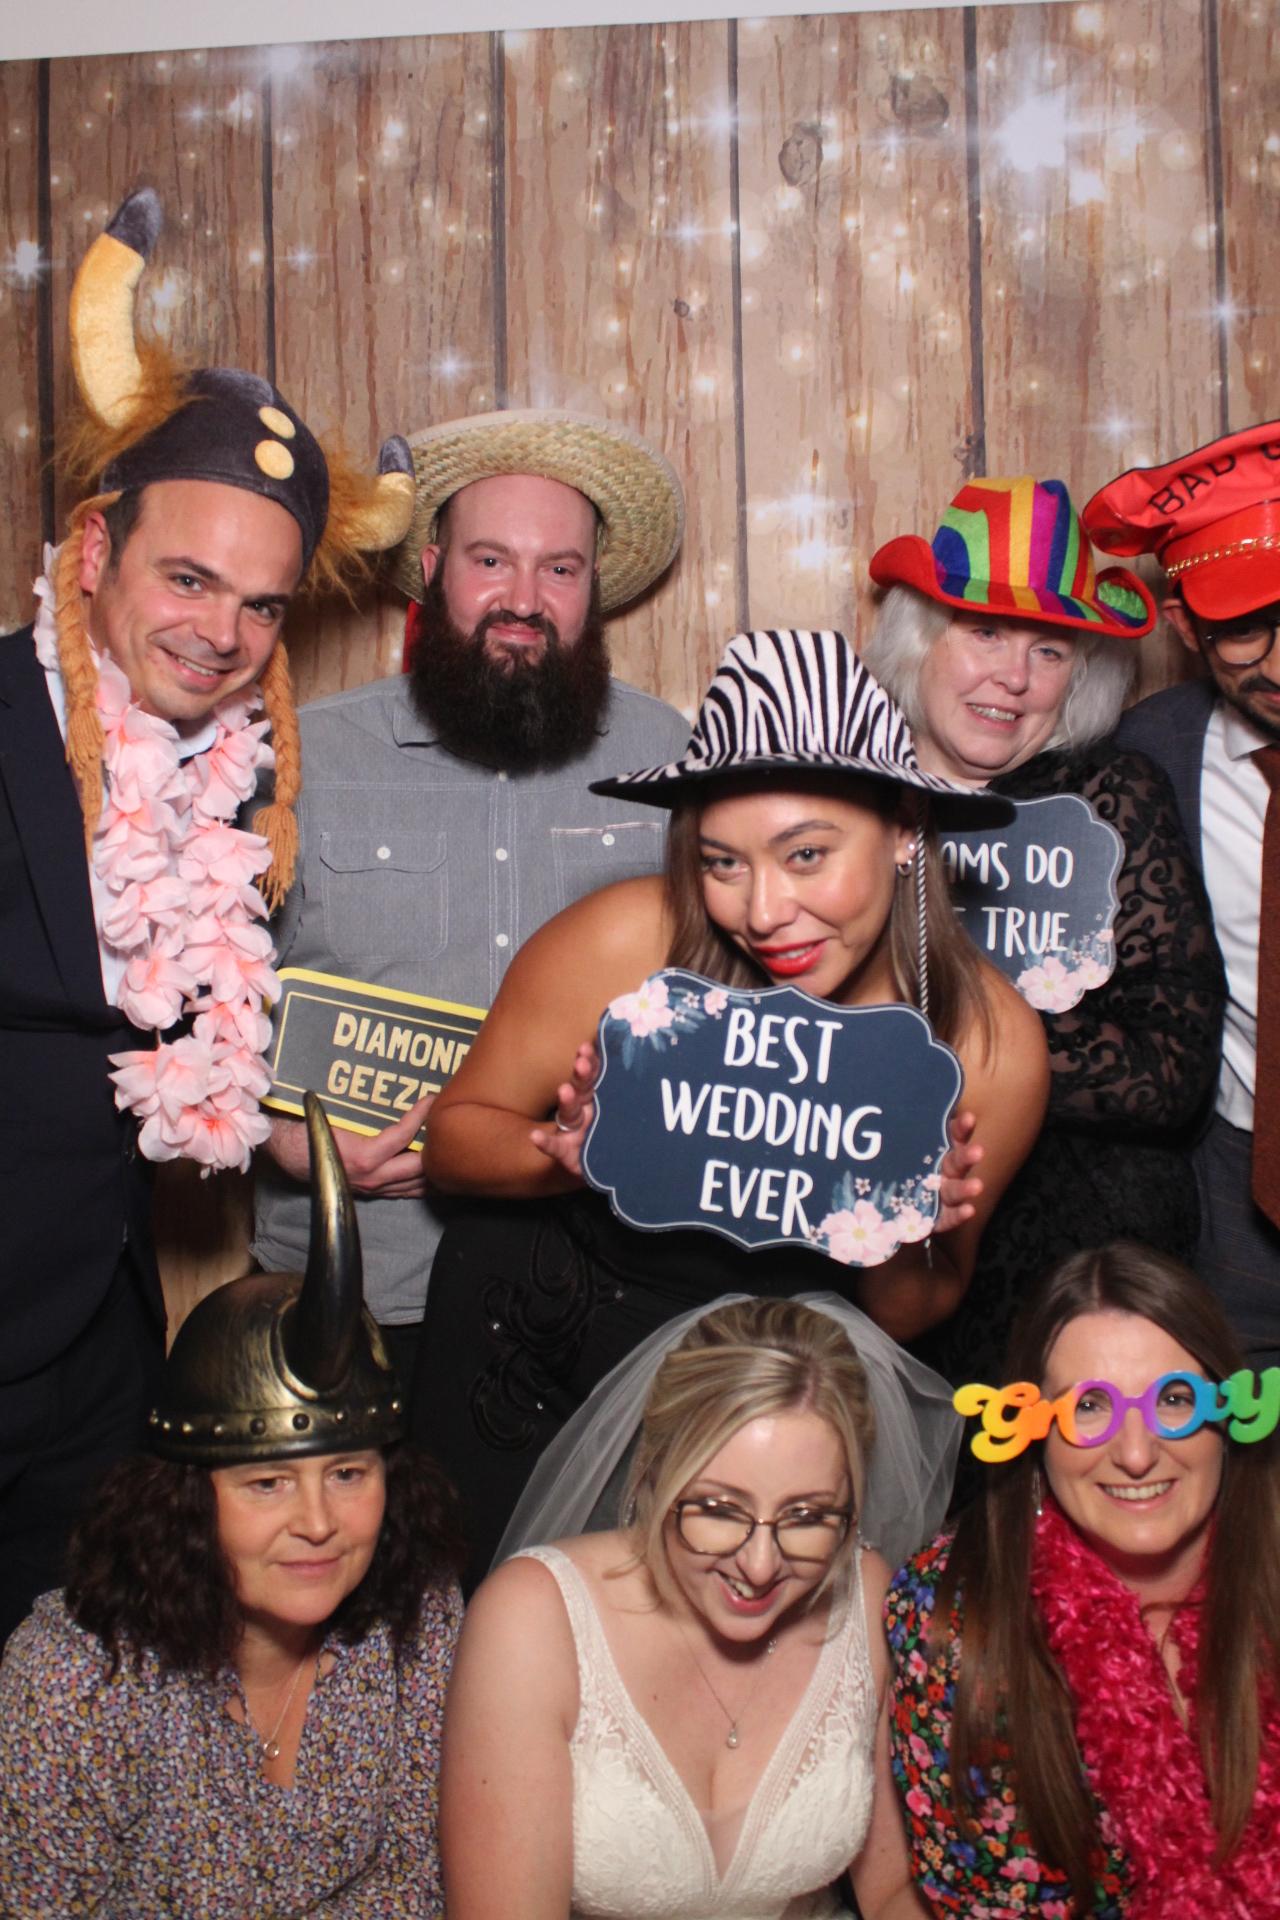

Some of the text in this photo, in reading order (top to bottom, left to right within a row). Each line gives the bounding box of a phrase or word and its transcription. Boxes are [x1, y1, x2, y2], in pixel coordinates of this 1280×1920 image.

[1149, 454, 1236, 515] BAD
[1026, 845, 1073, 888] DO
[981, 906, 1070, 958] TRUE
[723, 1008, 843, 1084] BEST
[661, 1078, 882, 1160] WEDDING
[699, 1159, 814, 1236] EVER
